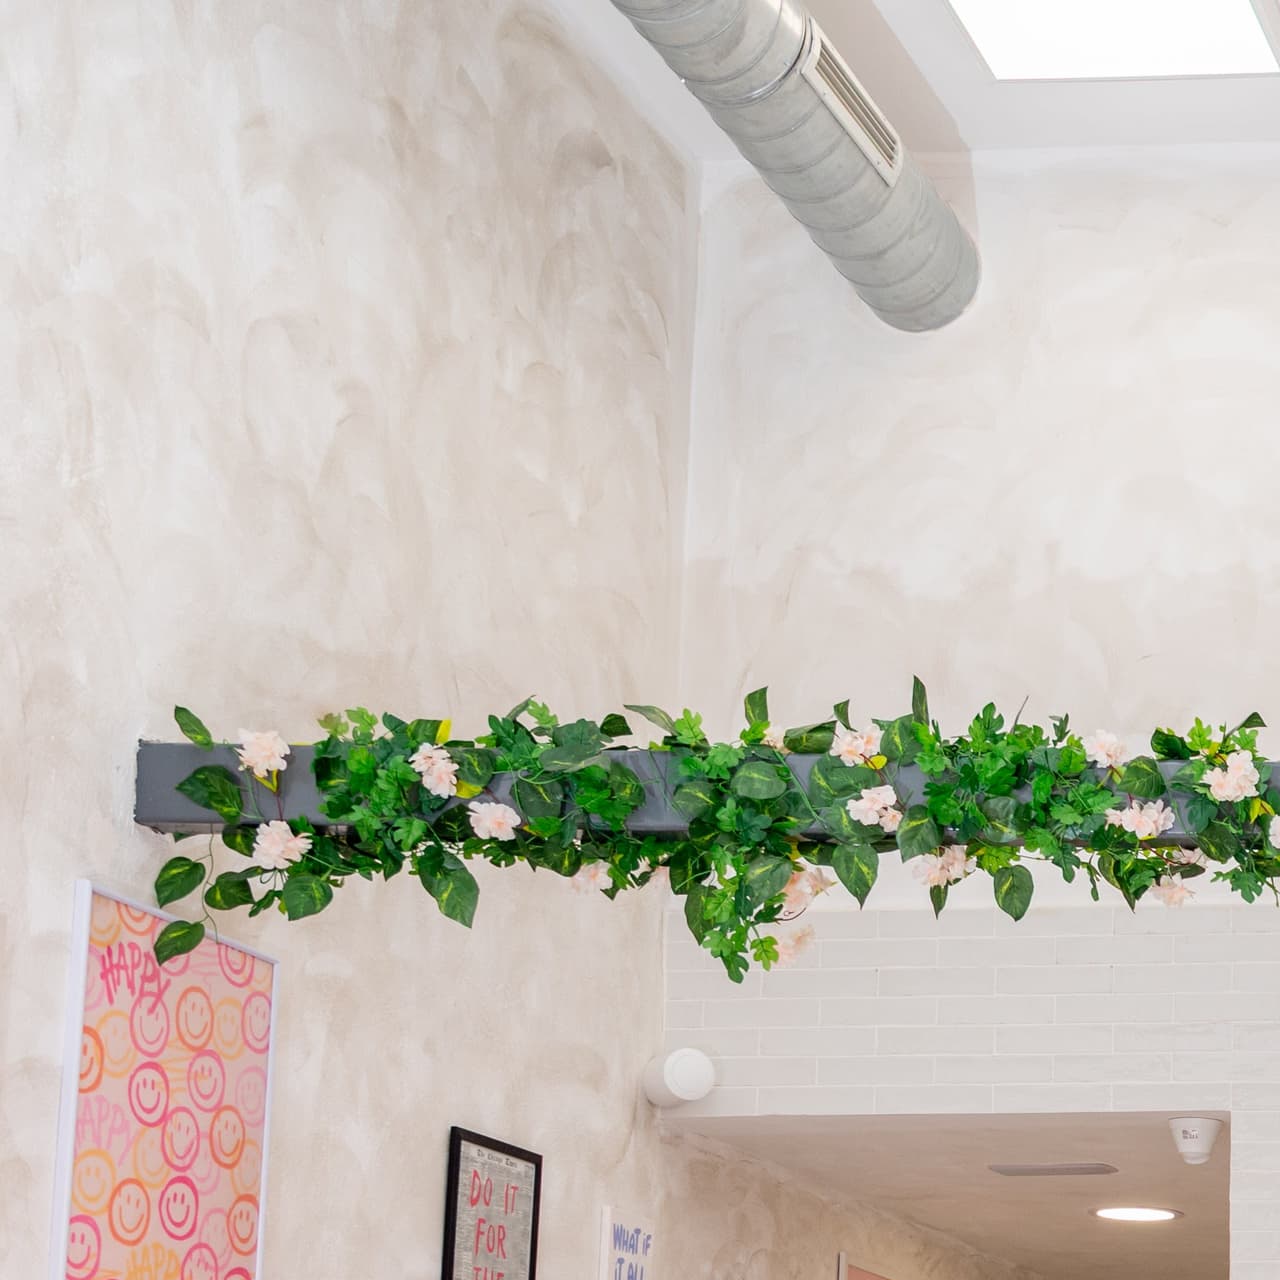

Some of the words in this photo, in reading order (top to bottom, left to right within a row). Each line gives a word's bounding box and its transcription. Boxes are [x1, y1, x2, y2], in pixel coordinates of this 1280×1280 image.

[470, 1169, 493, 1208] DO
[504, 1183, 519, 1216] IT
[474, 1218, 506, 1259] FOR
[612, 1223, 641, 1255] WHAT
